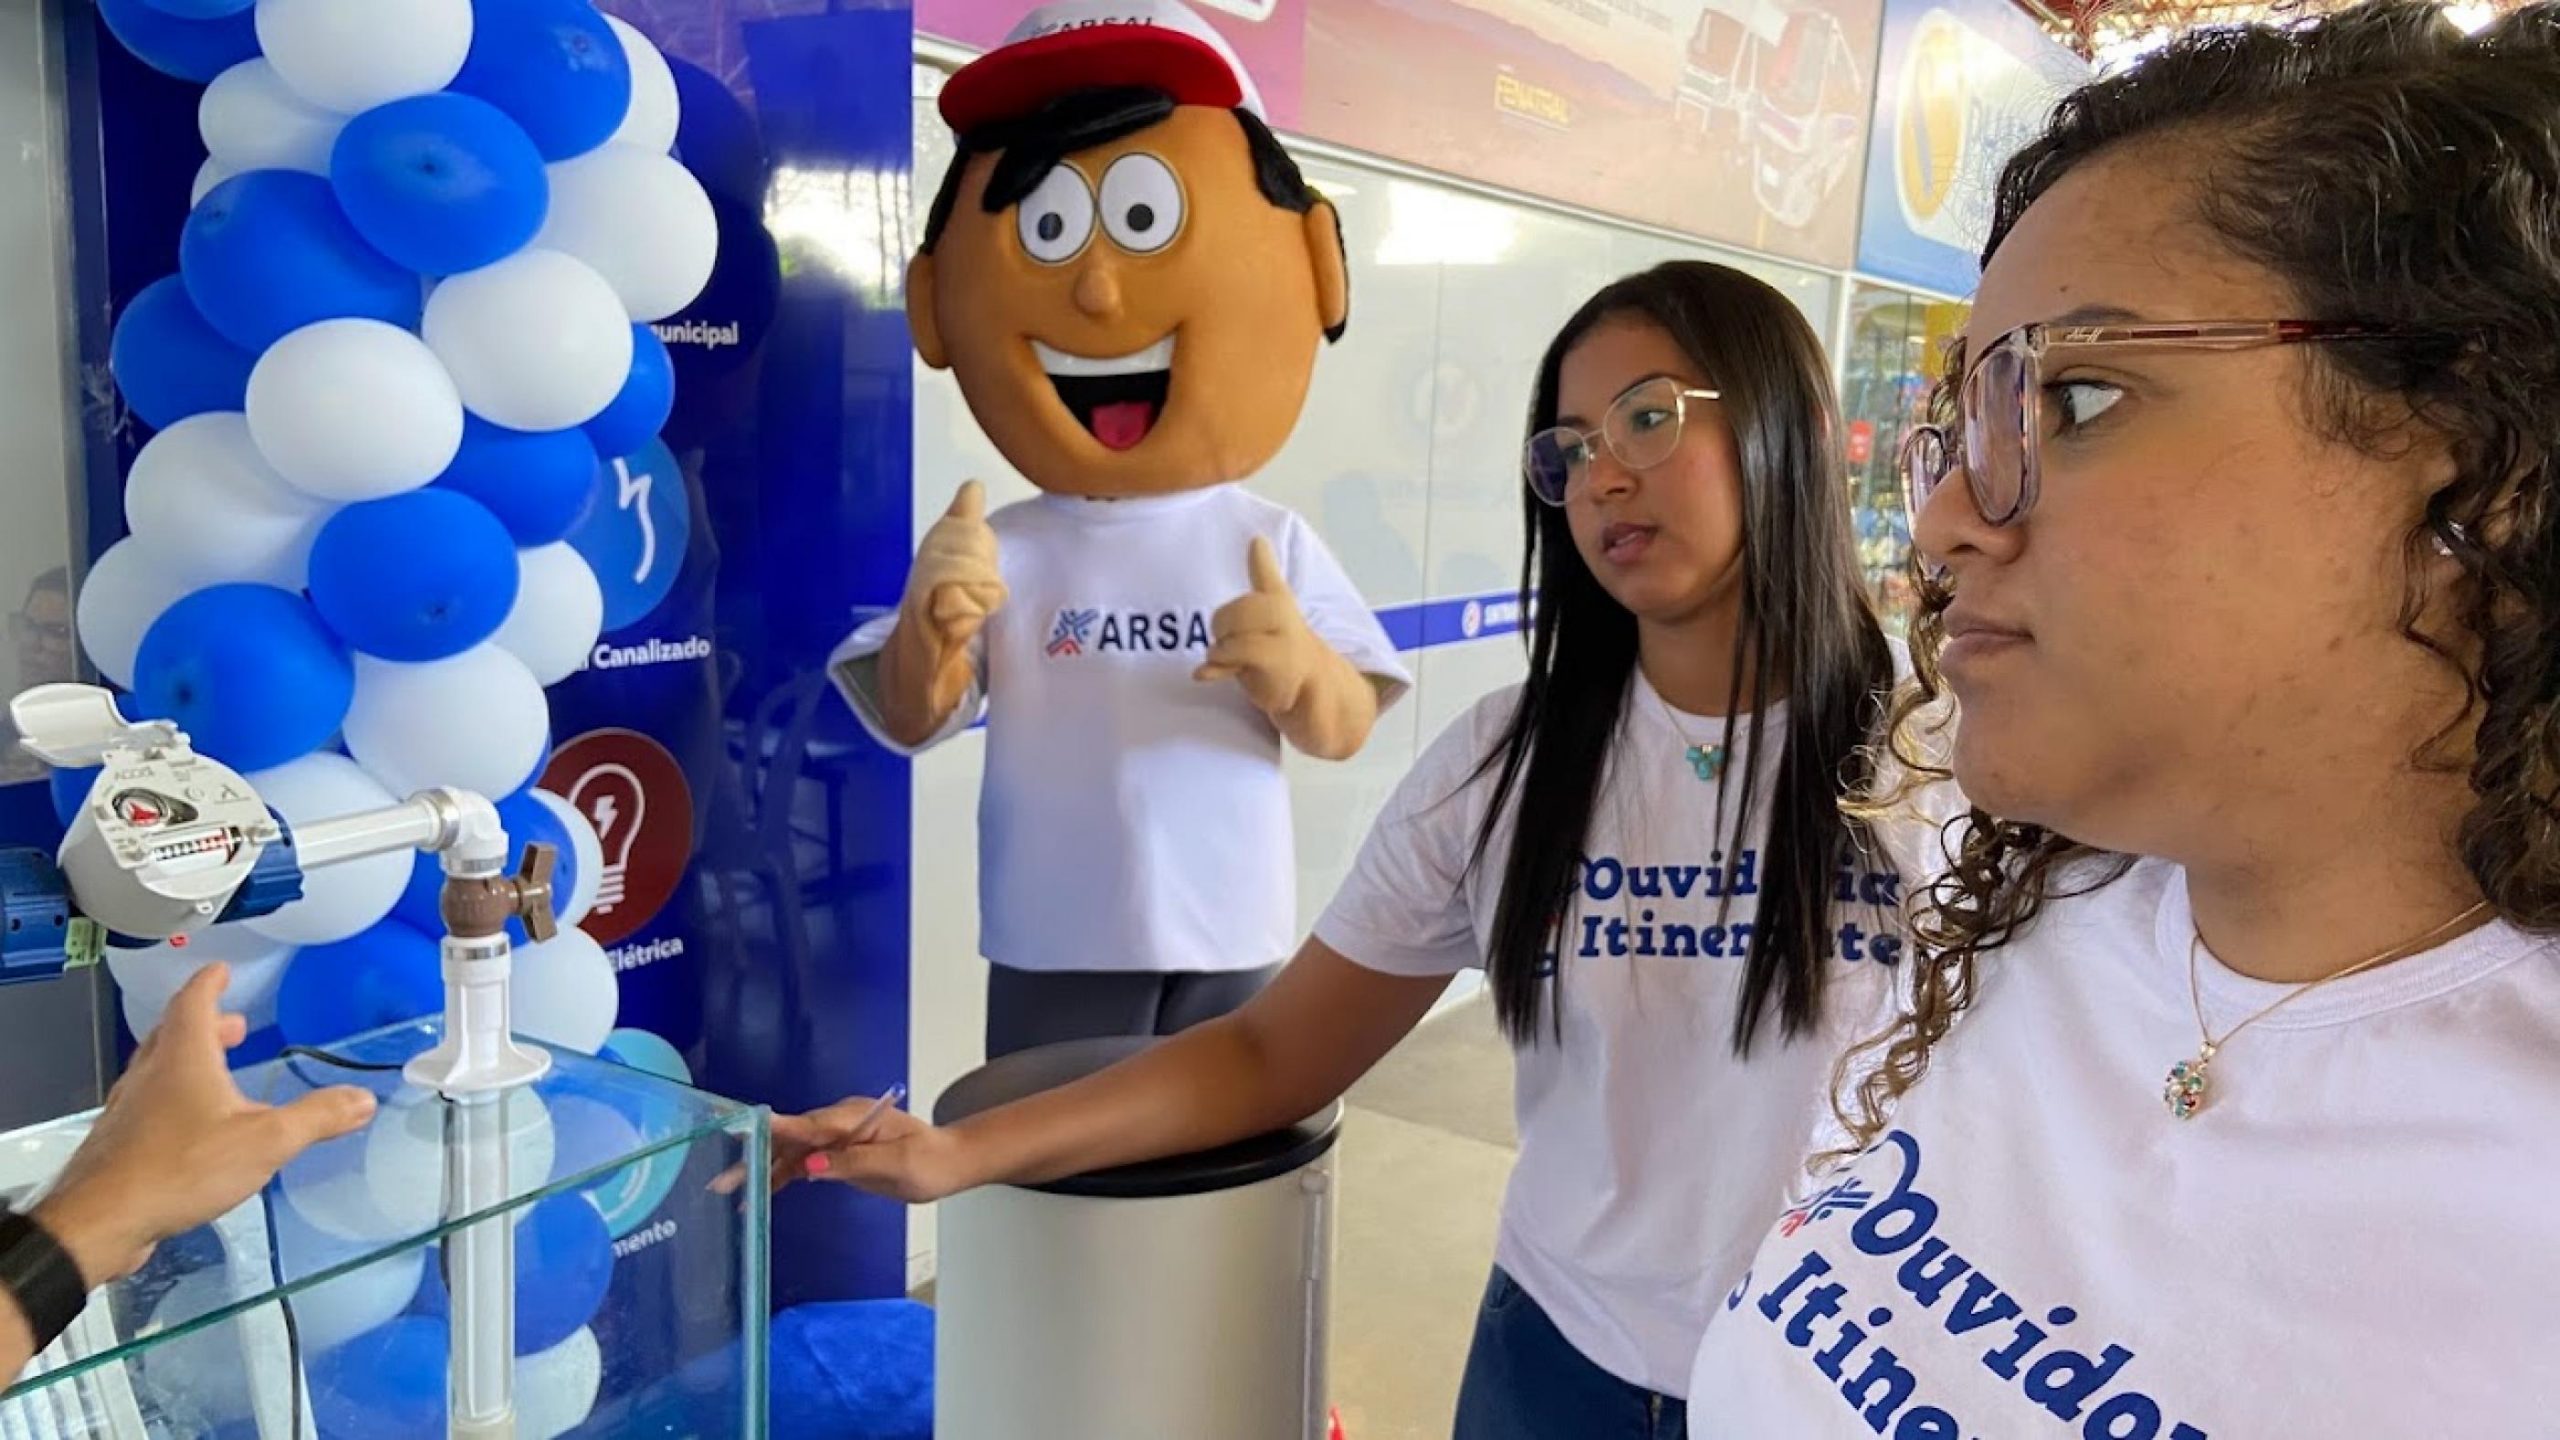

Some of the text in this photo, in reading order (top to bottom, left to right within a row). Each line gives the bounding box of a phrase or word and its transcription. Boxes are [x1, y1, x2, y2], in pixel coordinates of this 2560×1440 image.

[594, 634, 711, 670] Canalizado
[1584, 850, 1901, 906] Ouvidia
[1579, 909, 1902, 966] Itinerte
[1850, 1190, 2208, 1440] Ouvido
[1757, 1251, 1979, 1440] Itine
